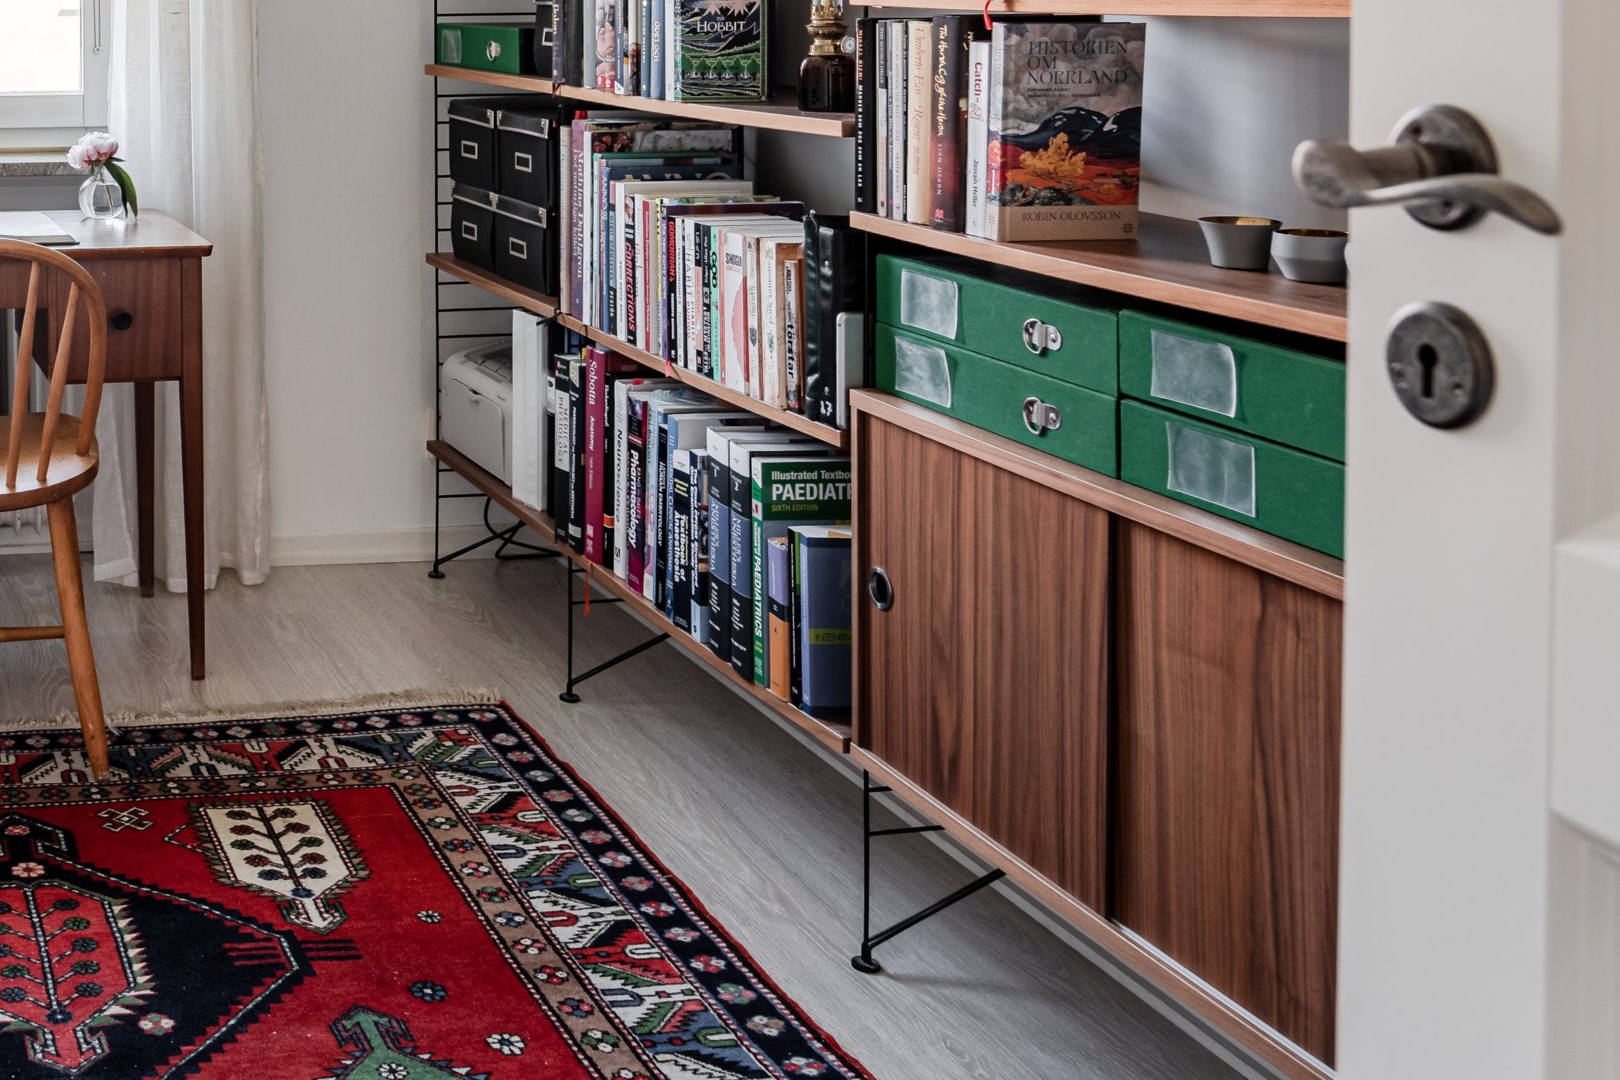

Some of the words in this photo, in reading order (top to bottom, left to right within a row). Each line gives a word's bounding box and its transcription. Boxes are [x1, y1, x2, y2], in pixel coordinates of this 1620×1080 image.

[697, 20, 746, 33] HOBBIT
[1027, 39, 1128, 56] HISTORIEN
[1026, 56, 1057, 70] OM
[1027, 70, 1128, 85] NORRLAND
[1021, 211, 1057, 222] ROBIN
[668, 220, 677, 277] GOMORRAH
[624, 240, 636, 332] CORRECTIONS
[786, 323, 796, 379] törstar
[587, 360, 598, 406] Sobotta
[588, 415, 596, 451] Anatomy
[615, 429, 624, 524] Neuroscience
[772, 470, 818, 481] Illustrated
[628, 449, 640, 549] Pharmacology
[771, 503, 791, 512] SIXTH
[792, 503, 819, 512] EDITION
[673, 510, 681, 583] Anaesthesia
[679, 514, 687, 567] Textbook
[753, 554, 763, 638] PAEDIATRICS
